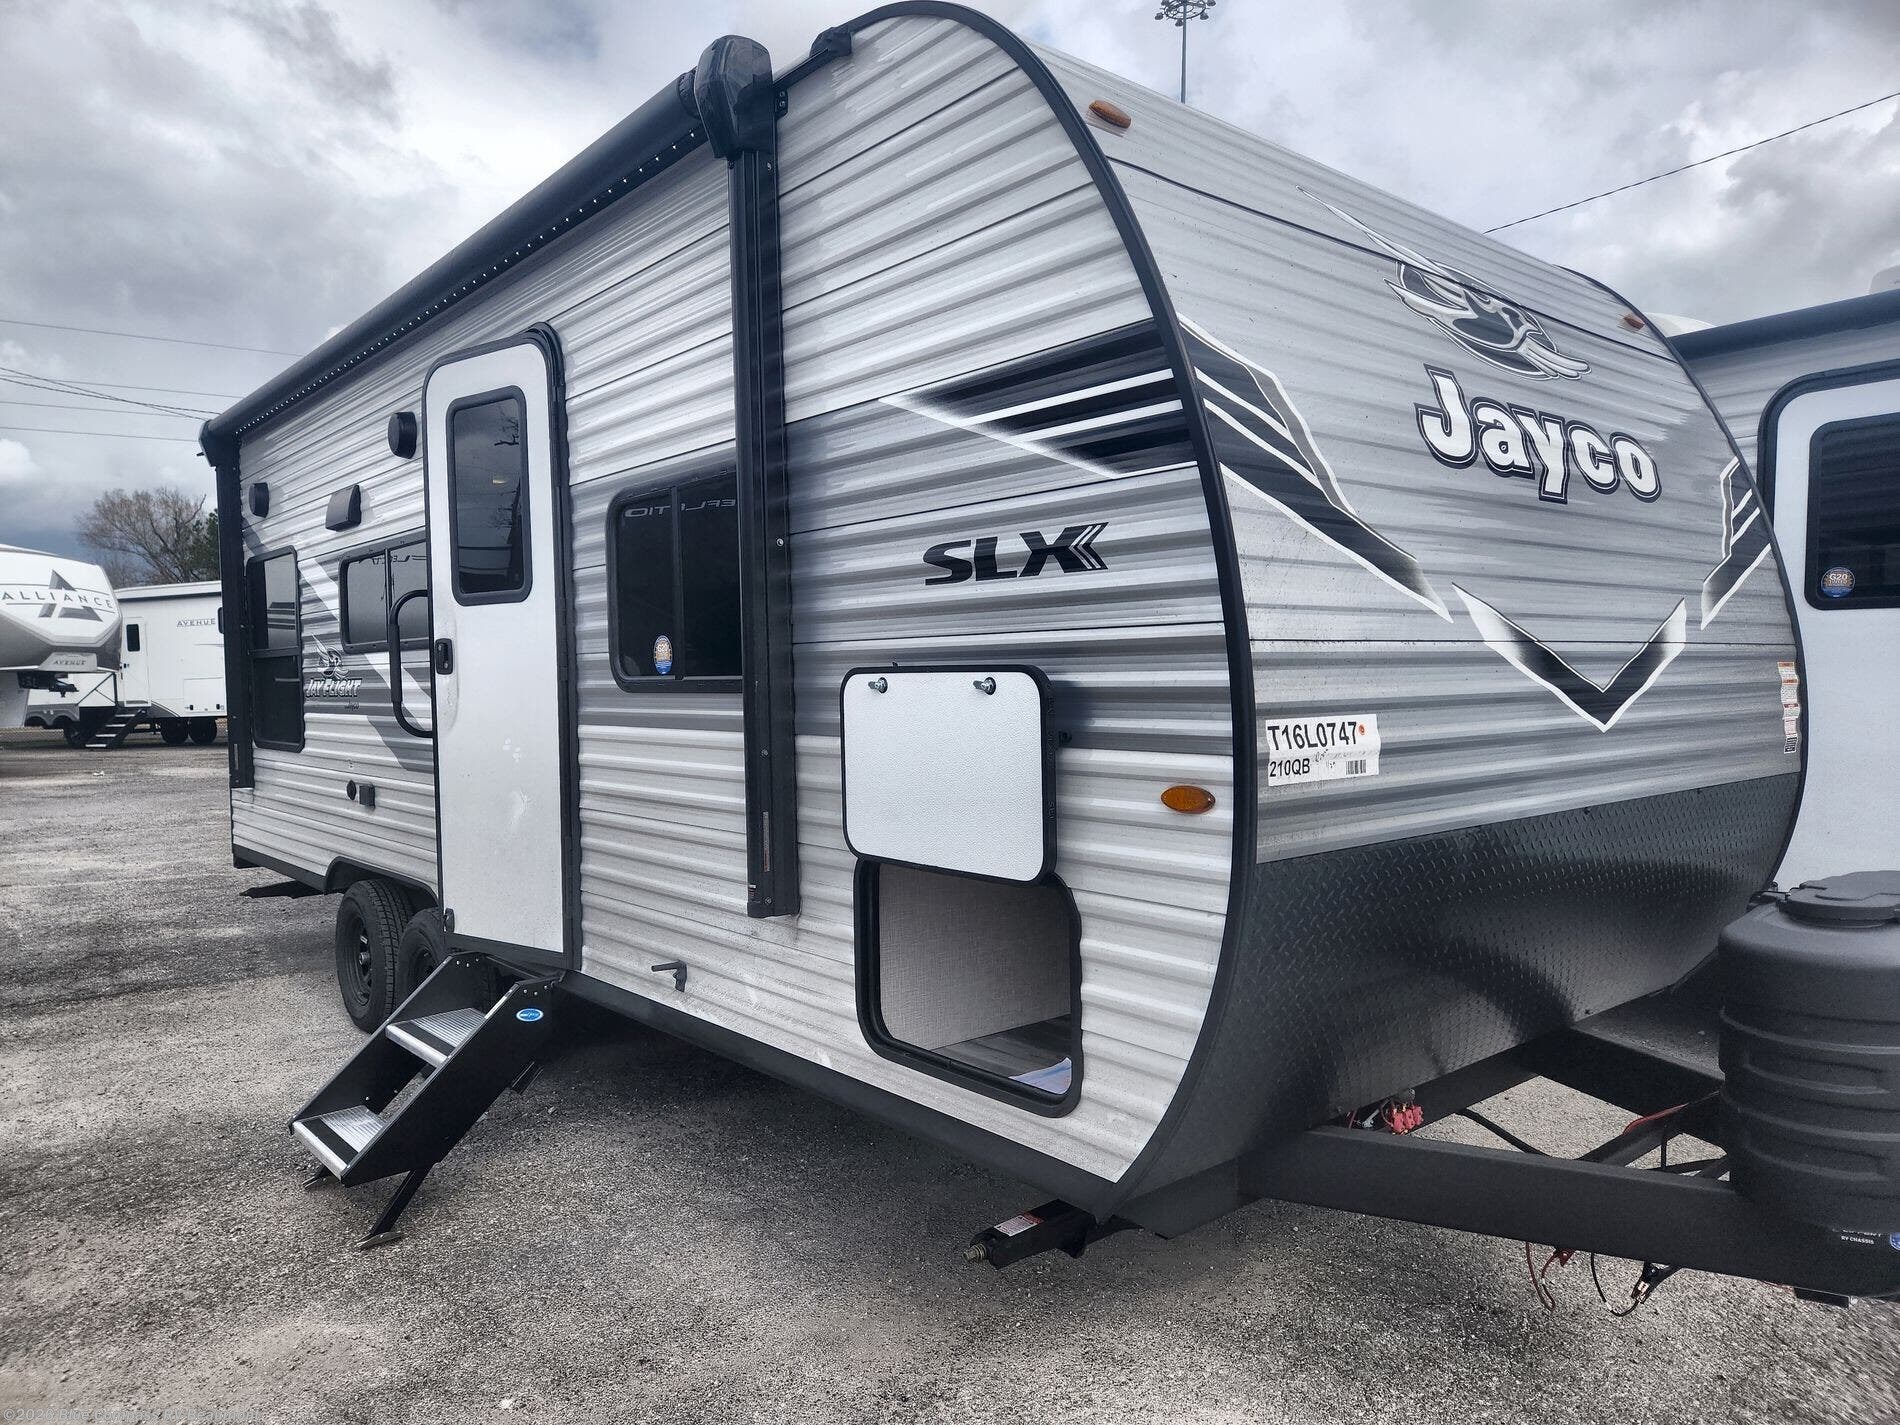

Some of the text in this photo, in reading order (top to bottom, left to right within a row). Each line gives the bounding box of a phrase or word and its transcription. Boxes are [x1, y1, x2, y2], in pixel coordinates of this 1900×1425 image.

[1414, 363, 1662, 504] Jayco
[922, 521, 1109, 586] SLX
[1, 590, 114, 609] ALLIANCE
[176, 618, 216, 628] AVENUE
[305, 677, 362, 698] JAY FLIGHT
[1267, 721, 1357, 750] T16L0747
[1269, 758, 1310, 777] 210QB
[1849, 1236, 1874, 1245] CHASSIS
